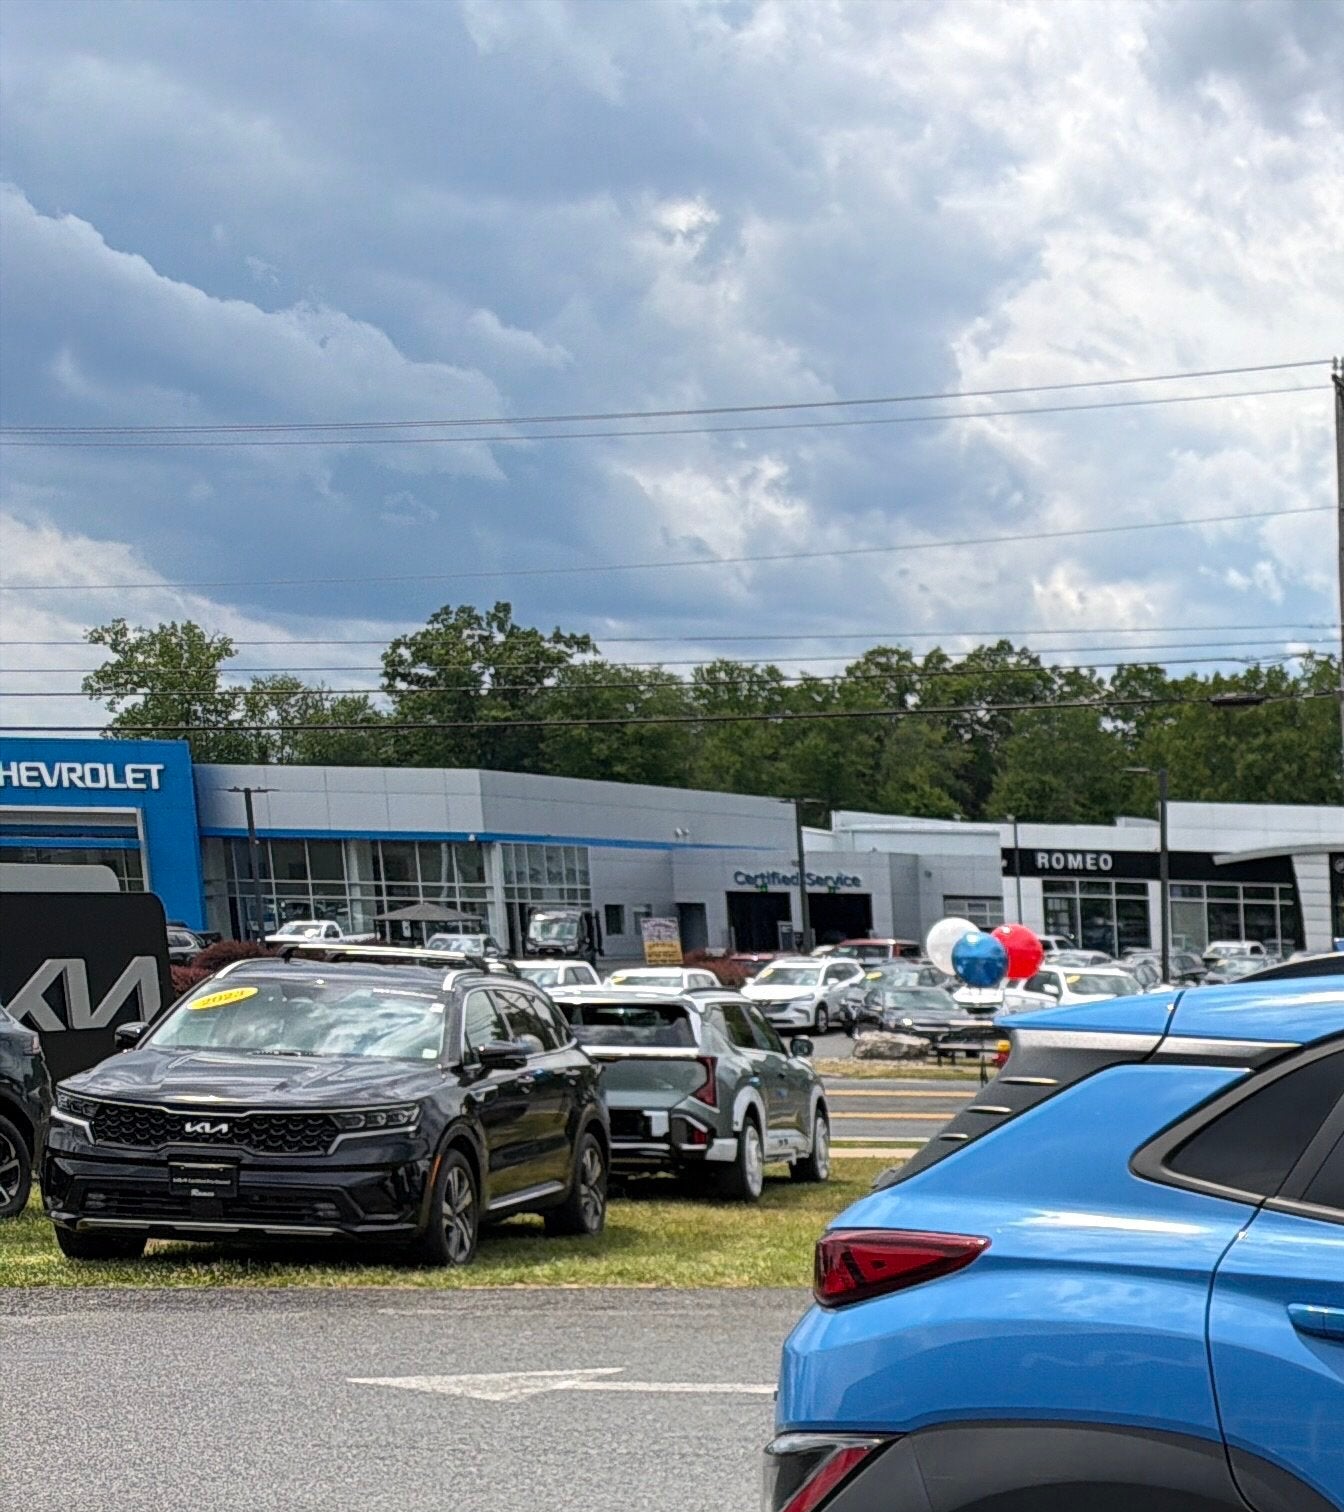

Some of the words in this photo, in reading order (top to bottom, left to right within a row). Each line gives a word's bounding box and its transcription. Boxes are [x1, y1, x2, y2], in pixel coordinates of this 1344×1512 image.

[1036, 852, 1113, 871] ROMEO
[734, 871, 800, 888] Certified
[805, 872, 861, 888] Service
